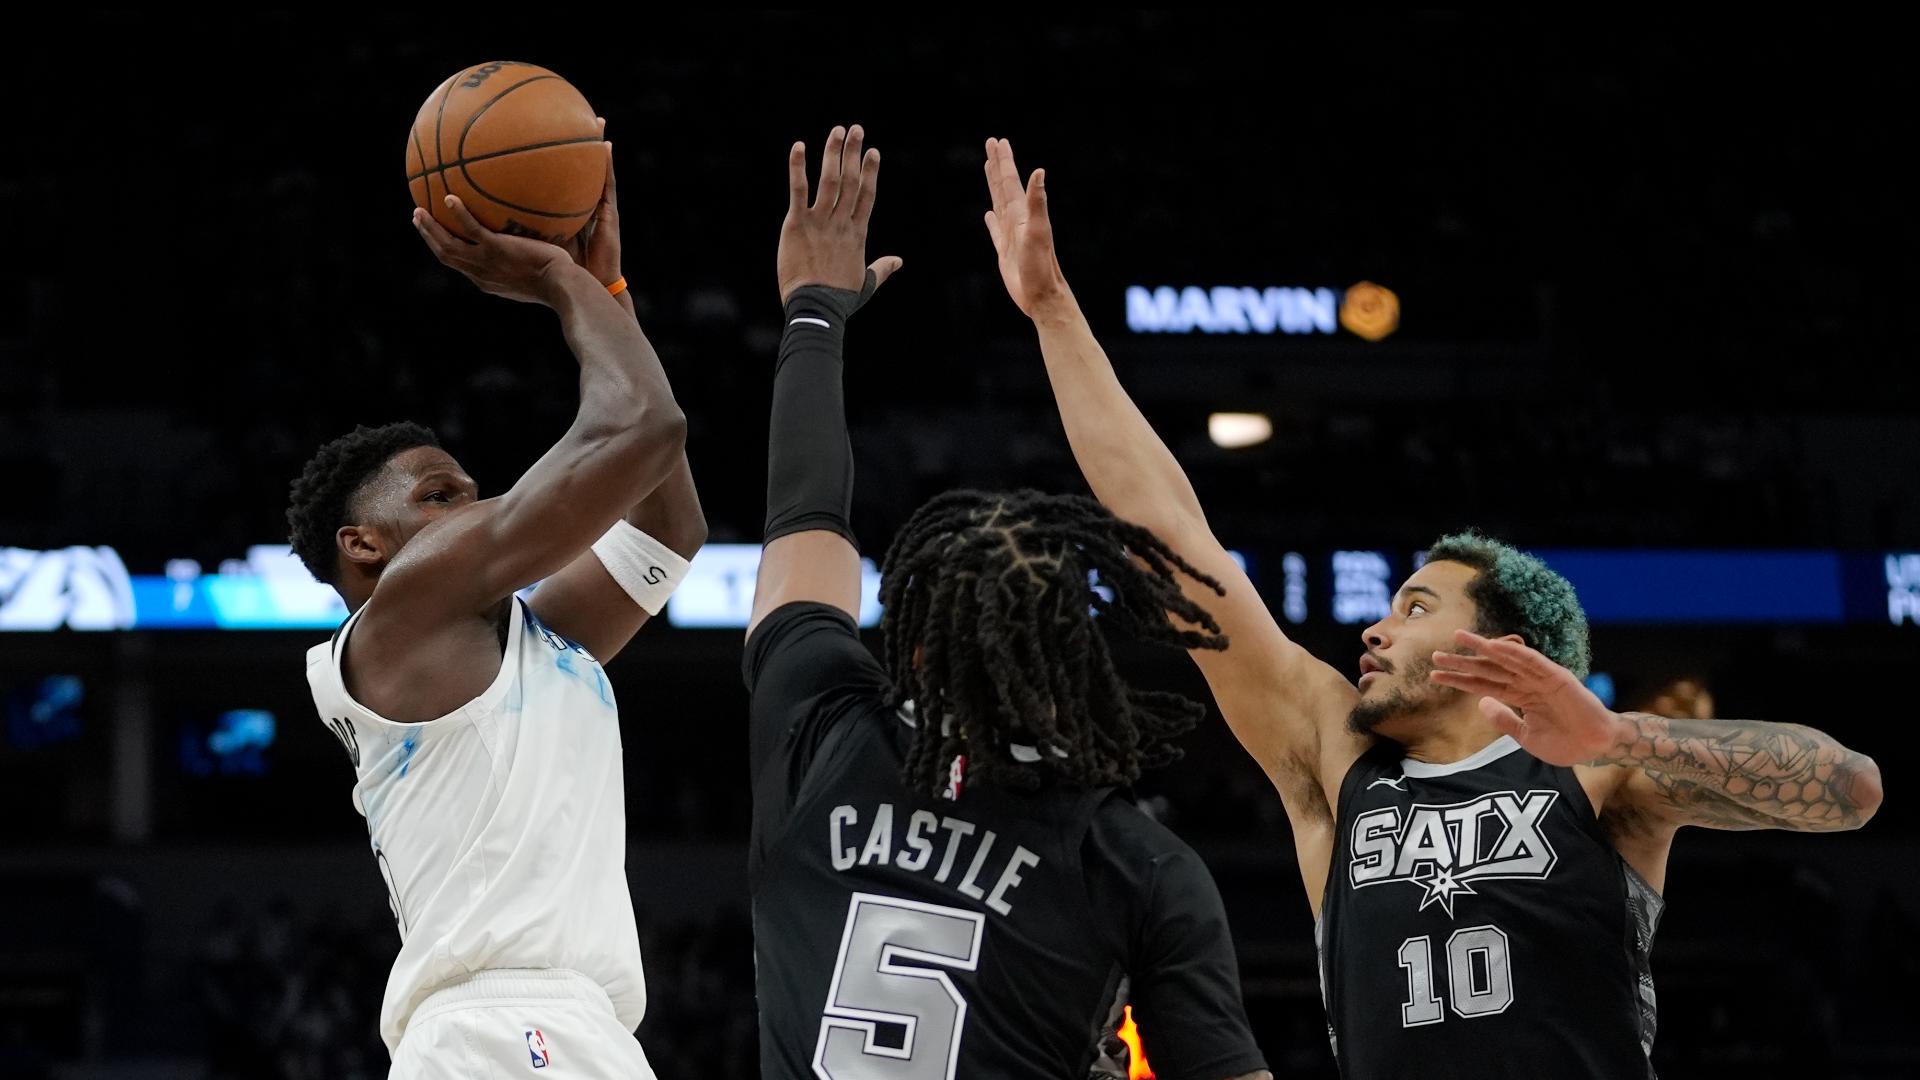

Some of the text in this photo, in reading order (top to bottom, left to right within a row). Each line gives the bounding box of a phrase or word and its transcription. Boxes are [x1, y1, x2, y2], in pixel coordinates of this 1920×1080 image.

[1125, 285, 1337, 334] MARVIN
[829, 803, 1041, 916] CASTLE
[1350, 789, 1559, 889] SATX
[811, 891, 986, 1080] 5
[1398, 924, 1514, 1028] 10
